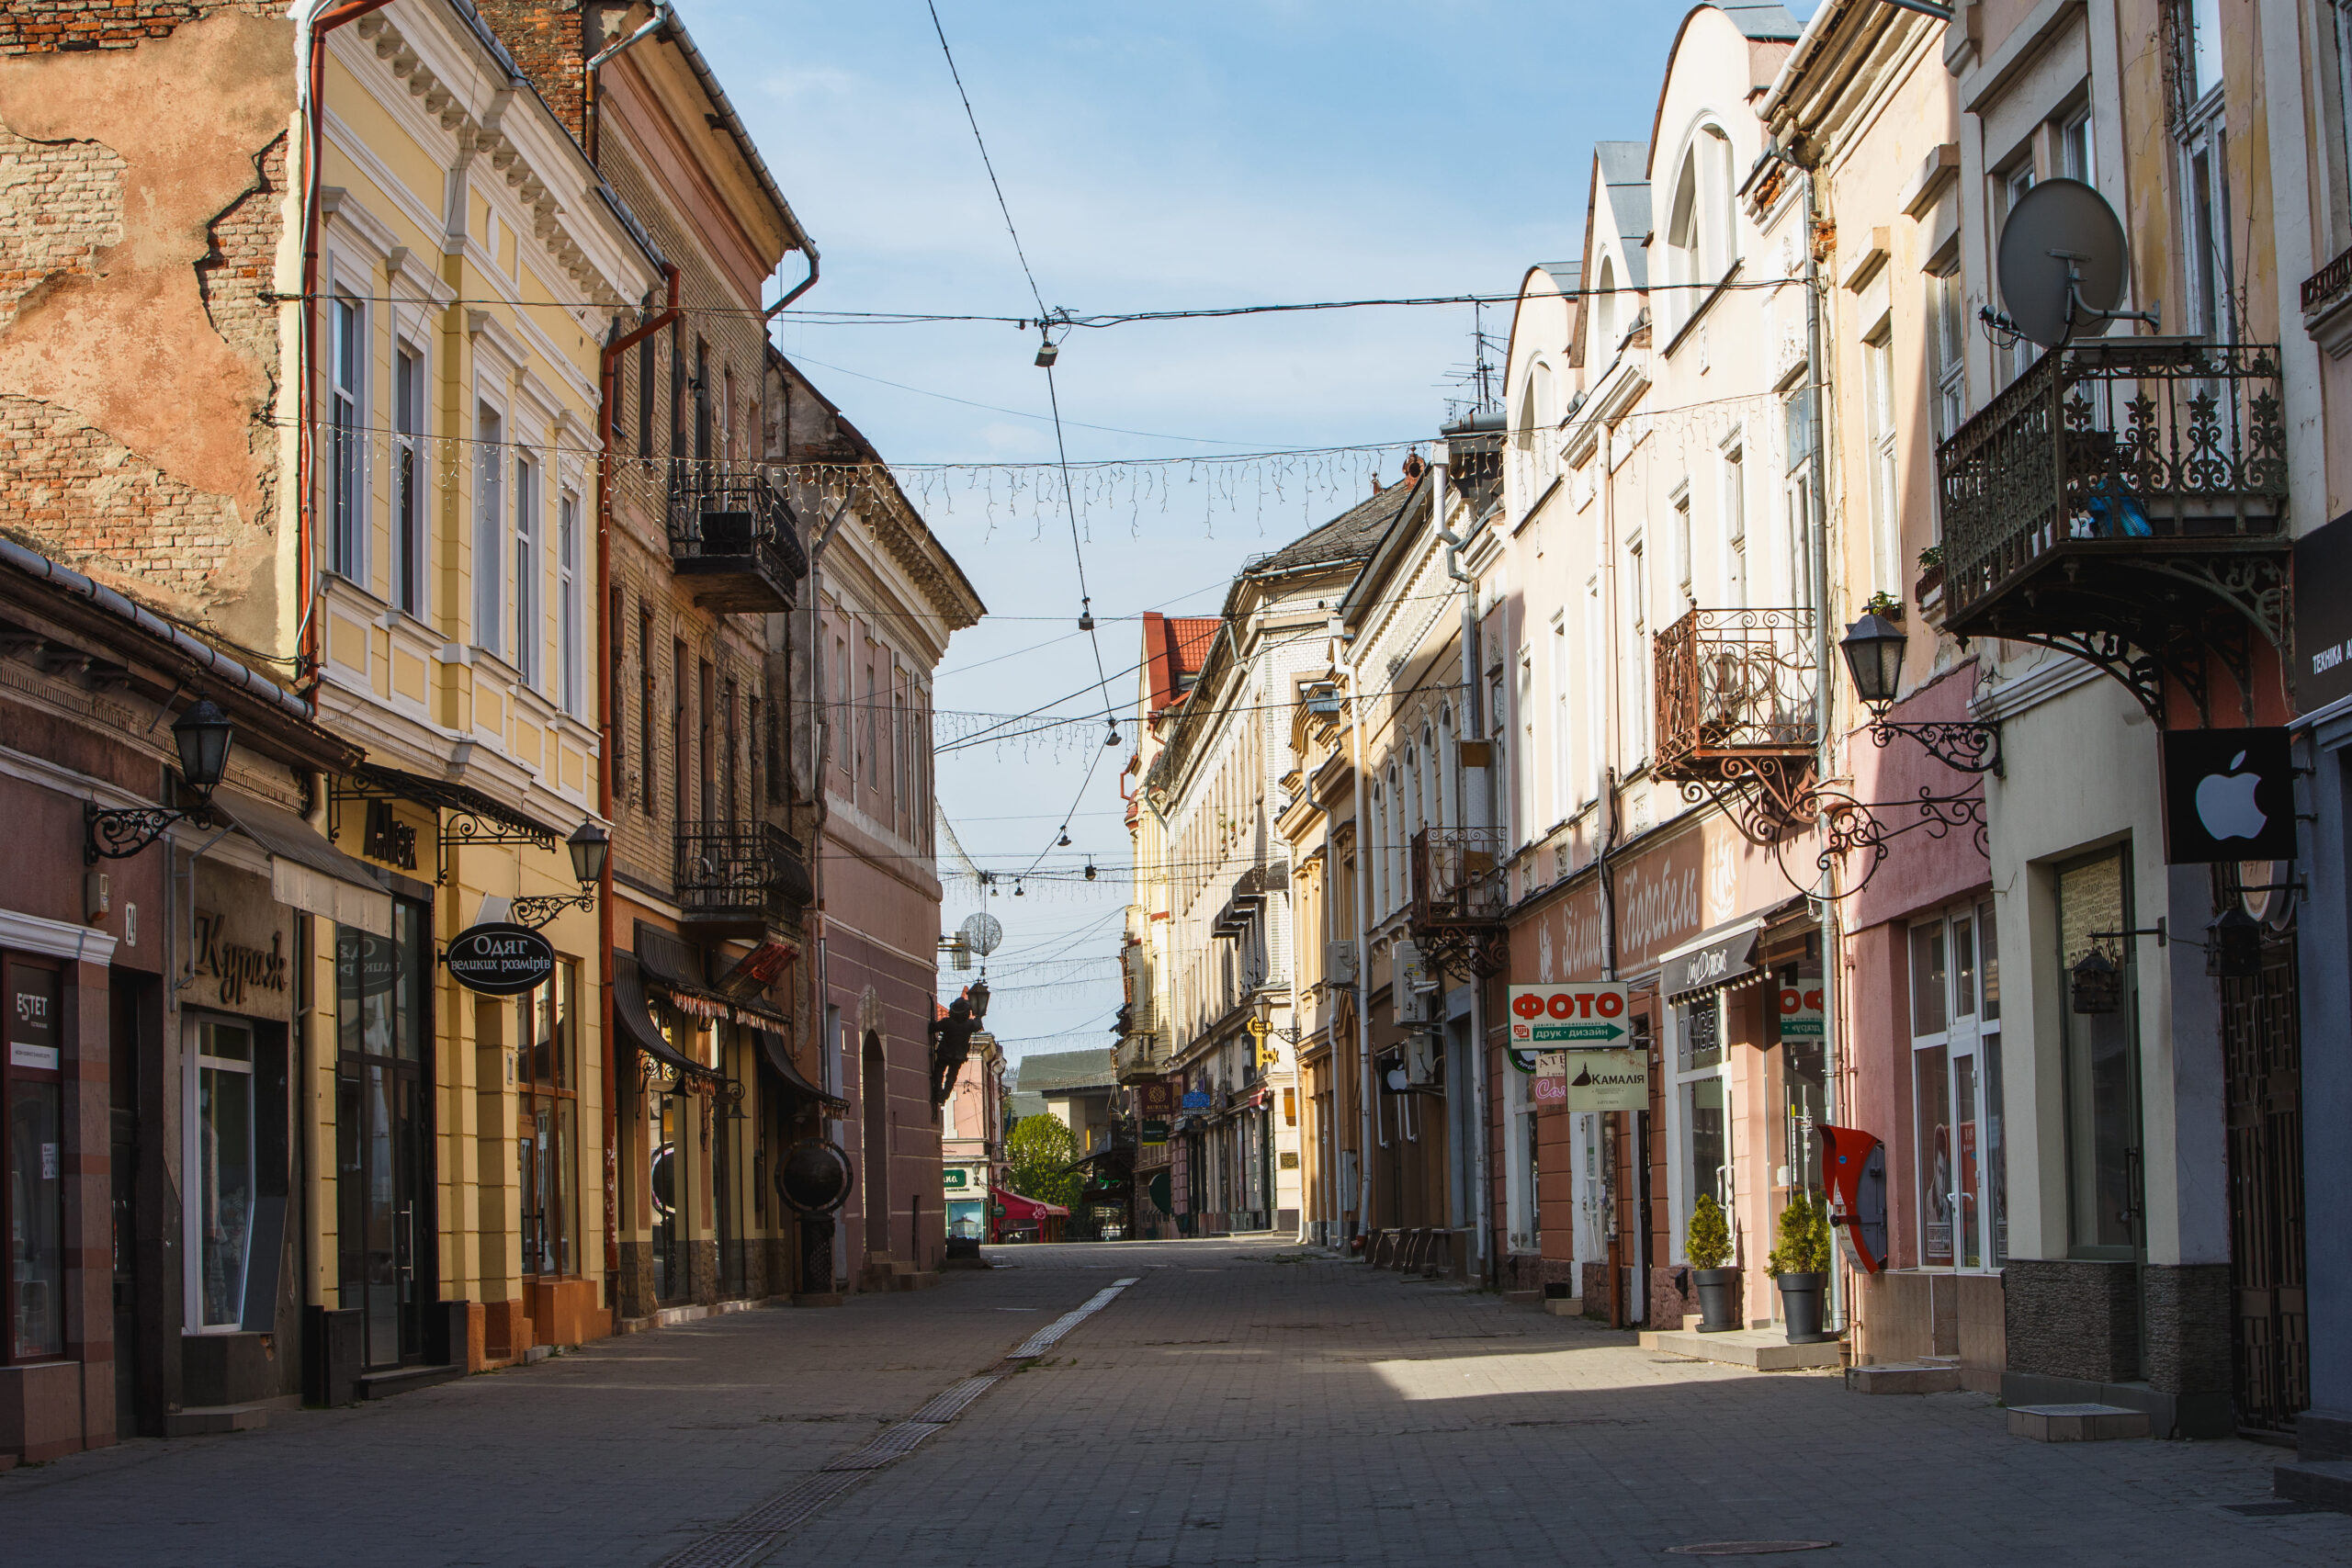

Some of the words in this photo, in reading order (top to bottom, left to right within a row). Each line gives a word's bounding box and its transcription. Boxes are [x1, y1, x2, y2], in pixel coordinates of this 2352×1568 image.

[2312, 644, 2343, 675] ТЕХНІКА
[127, 908, 136, 941] 24
[1623, 856, 1699, 965] Корабель
[186, 908, 288, 1004] Кураж
[474, 936, 528, 956] Одяг
[451, 959, 497, 970] великих
[502, 956, 551, 973] розмірів
[17, 992, 48, 1021] ESTET
[1512, 992, 1623, 1020] ФОТО
[1535, 1030, 1562, 1038] друк
[1568, 1027, 1608, 1037] дизайн
